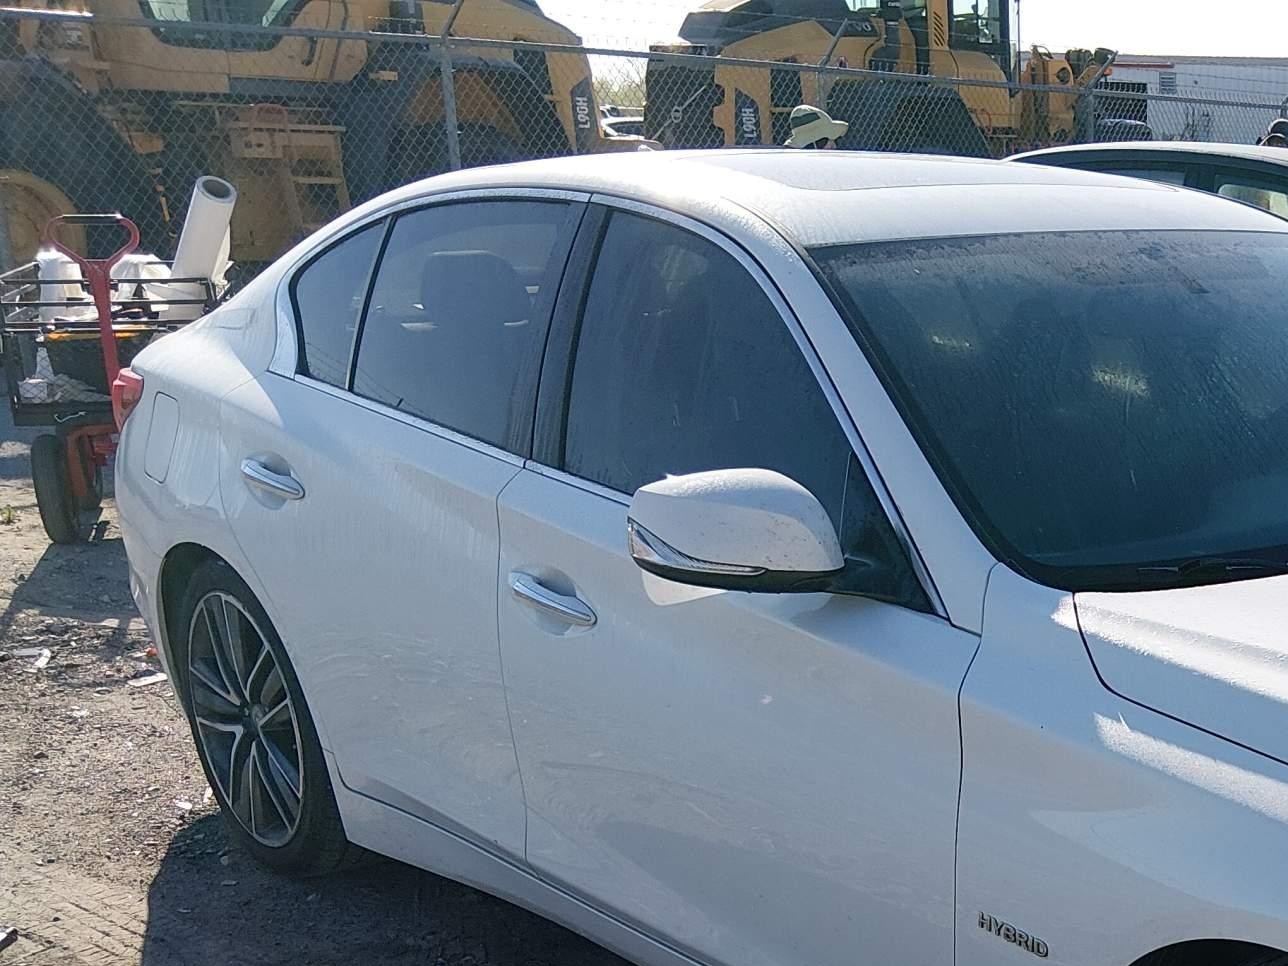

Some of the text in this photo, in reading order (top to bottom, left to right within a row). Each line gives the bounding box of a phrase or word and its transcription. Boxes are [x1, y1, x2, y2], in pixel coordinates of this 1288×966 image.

[575, 96, 591, 129] L90H
[741, 108, 757, 138] L90H
[977, 911, 1049, 958] HYBRID
